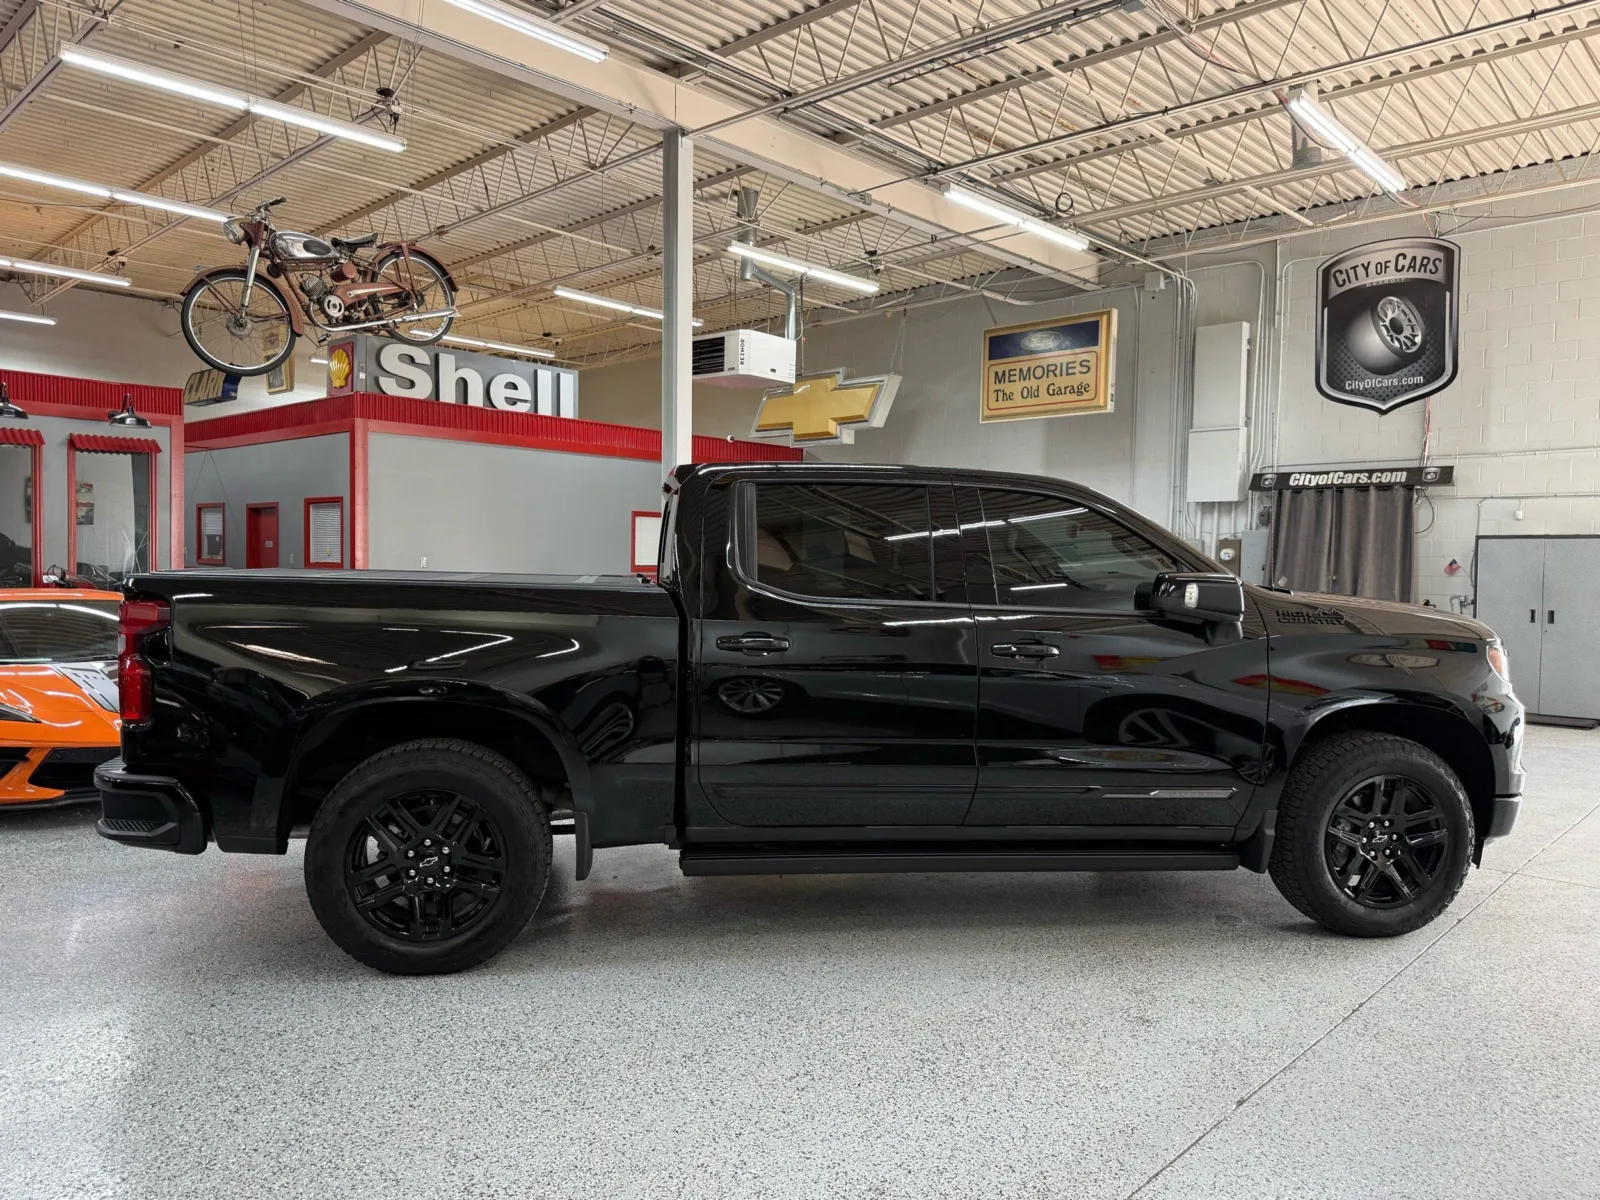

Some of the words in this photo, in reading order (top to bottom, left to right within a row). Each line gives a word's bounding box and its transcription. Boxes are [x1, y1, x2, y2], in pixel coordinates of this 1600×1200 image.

[1332, 261, 1371, 288] CITY
[1375, 260, 1391, 276] OF
[1394, 252, 1442, 275] CARS
[1027, 332, 1056, 348] Ford
[378, 344, 574, 418] Shell
[994, 359, 1091, 385] MEMORIES
[993, 389, 1014, 402] The
[1020, 385, 1040, 399] Old
[1046, 381, 1090, 397] Garage
[1345, 376, 1423, 390] CityOfCars.com
[1289, 471, 1407, 486] CityofCars.com
